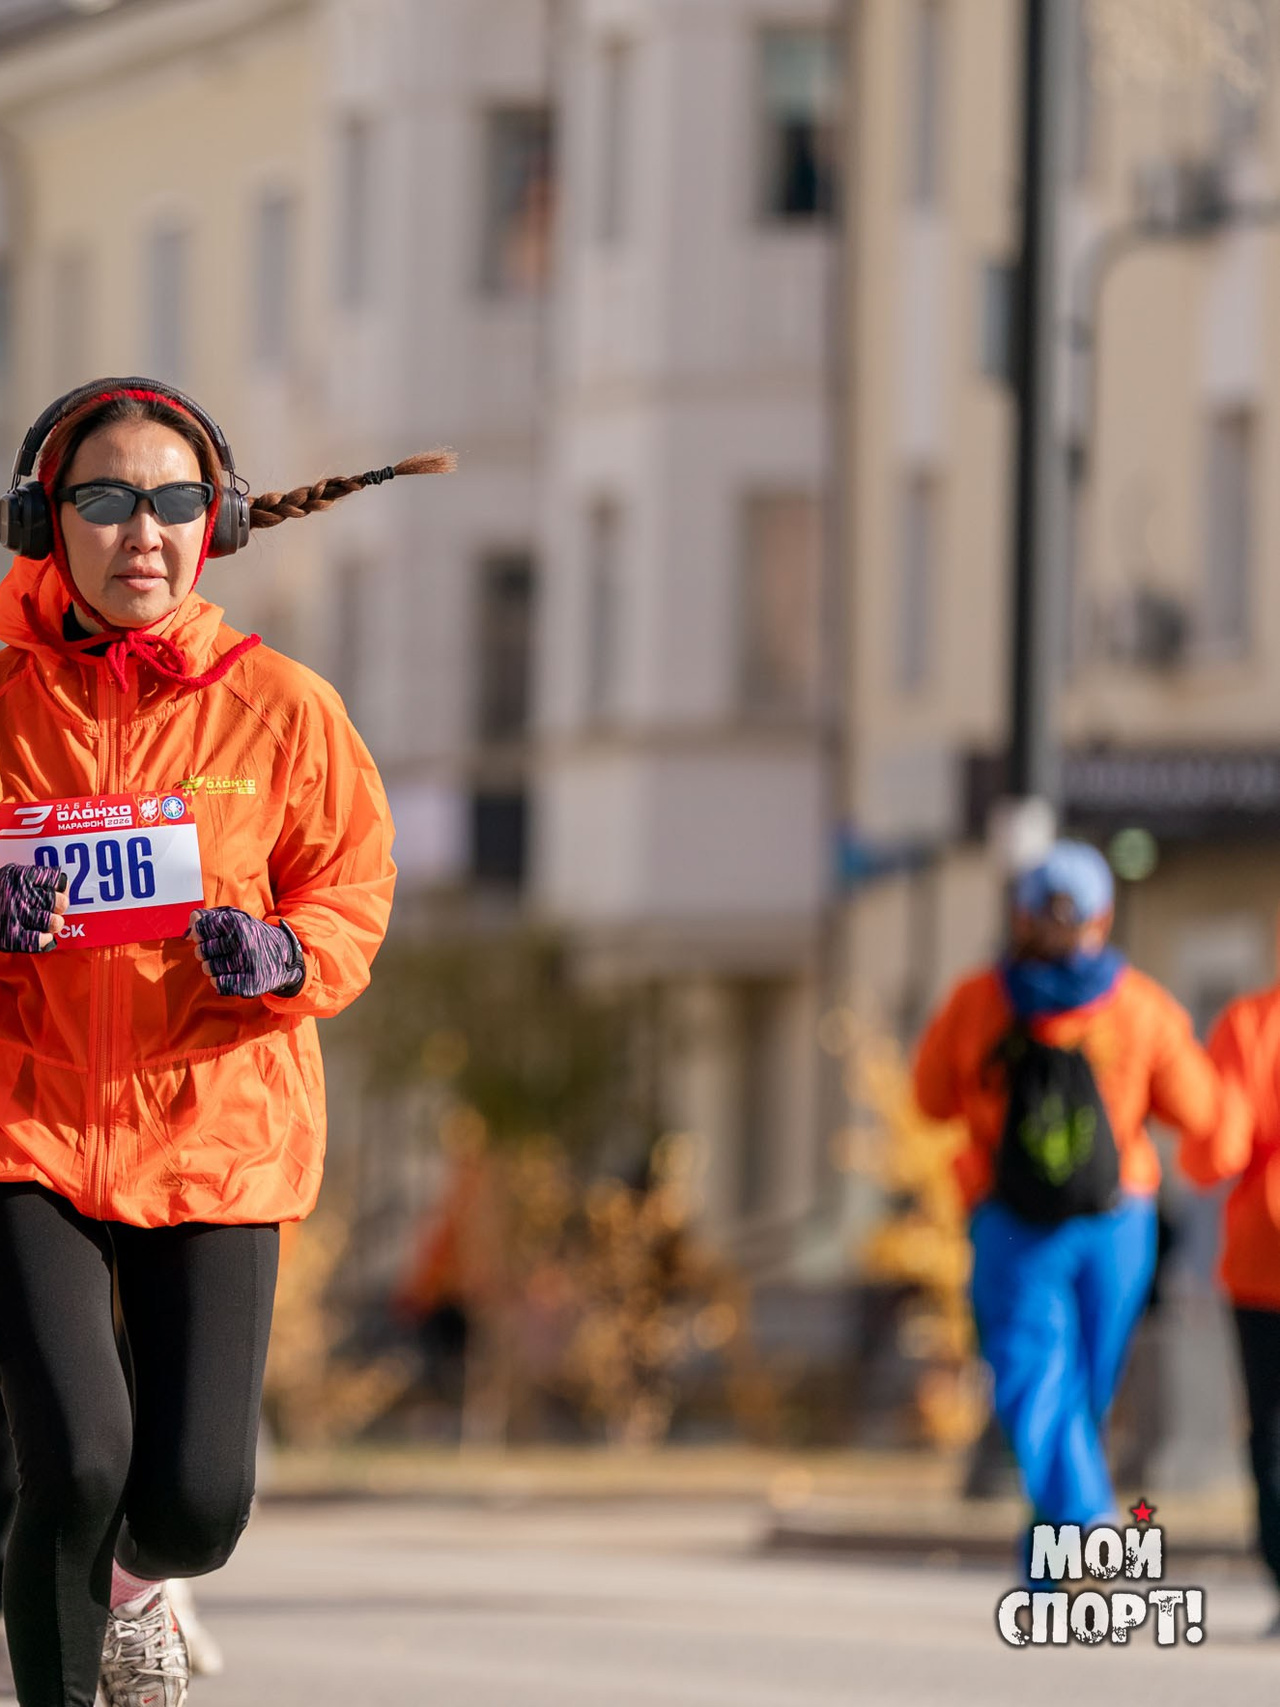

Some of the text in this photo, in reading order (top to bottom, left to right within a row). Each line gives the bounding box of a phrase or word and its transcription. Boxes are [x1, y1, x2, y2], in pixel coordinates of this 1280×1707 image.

[56, 800, 106, 811] ЗАБЕГ
[56, 805, 132, 822] ОЛОНХО
[57, 820, 104, 831] МАРАФОН
[57, 923, 86, 938] СК
